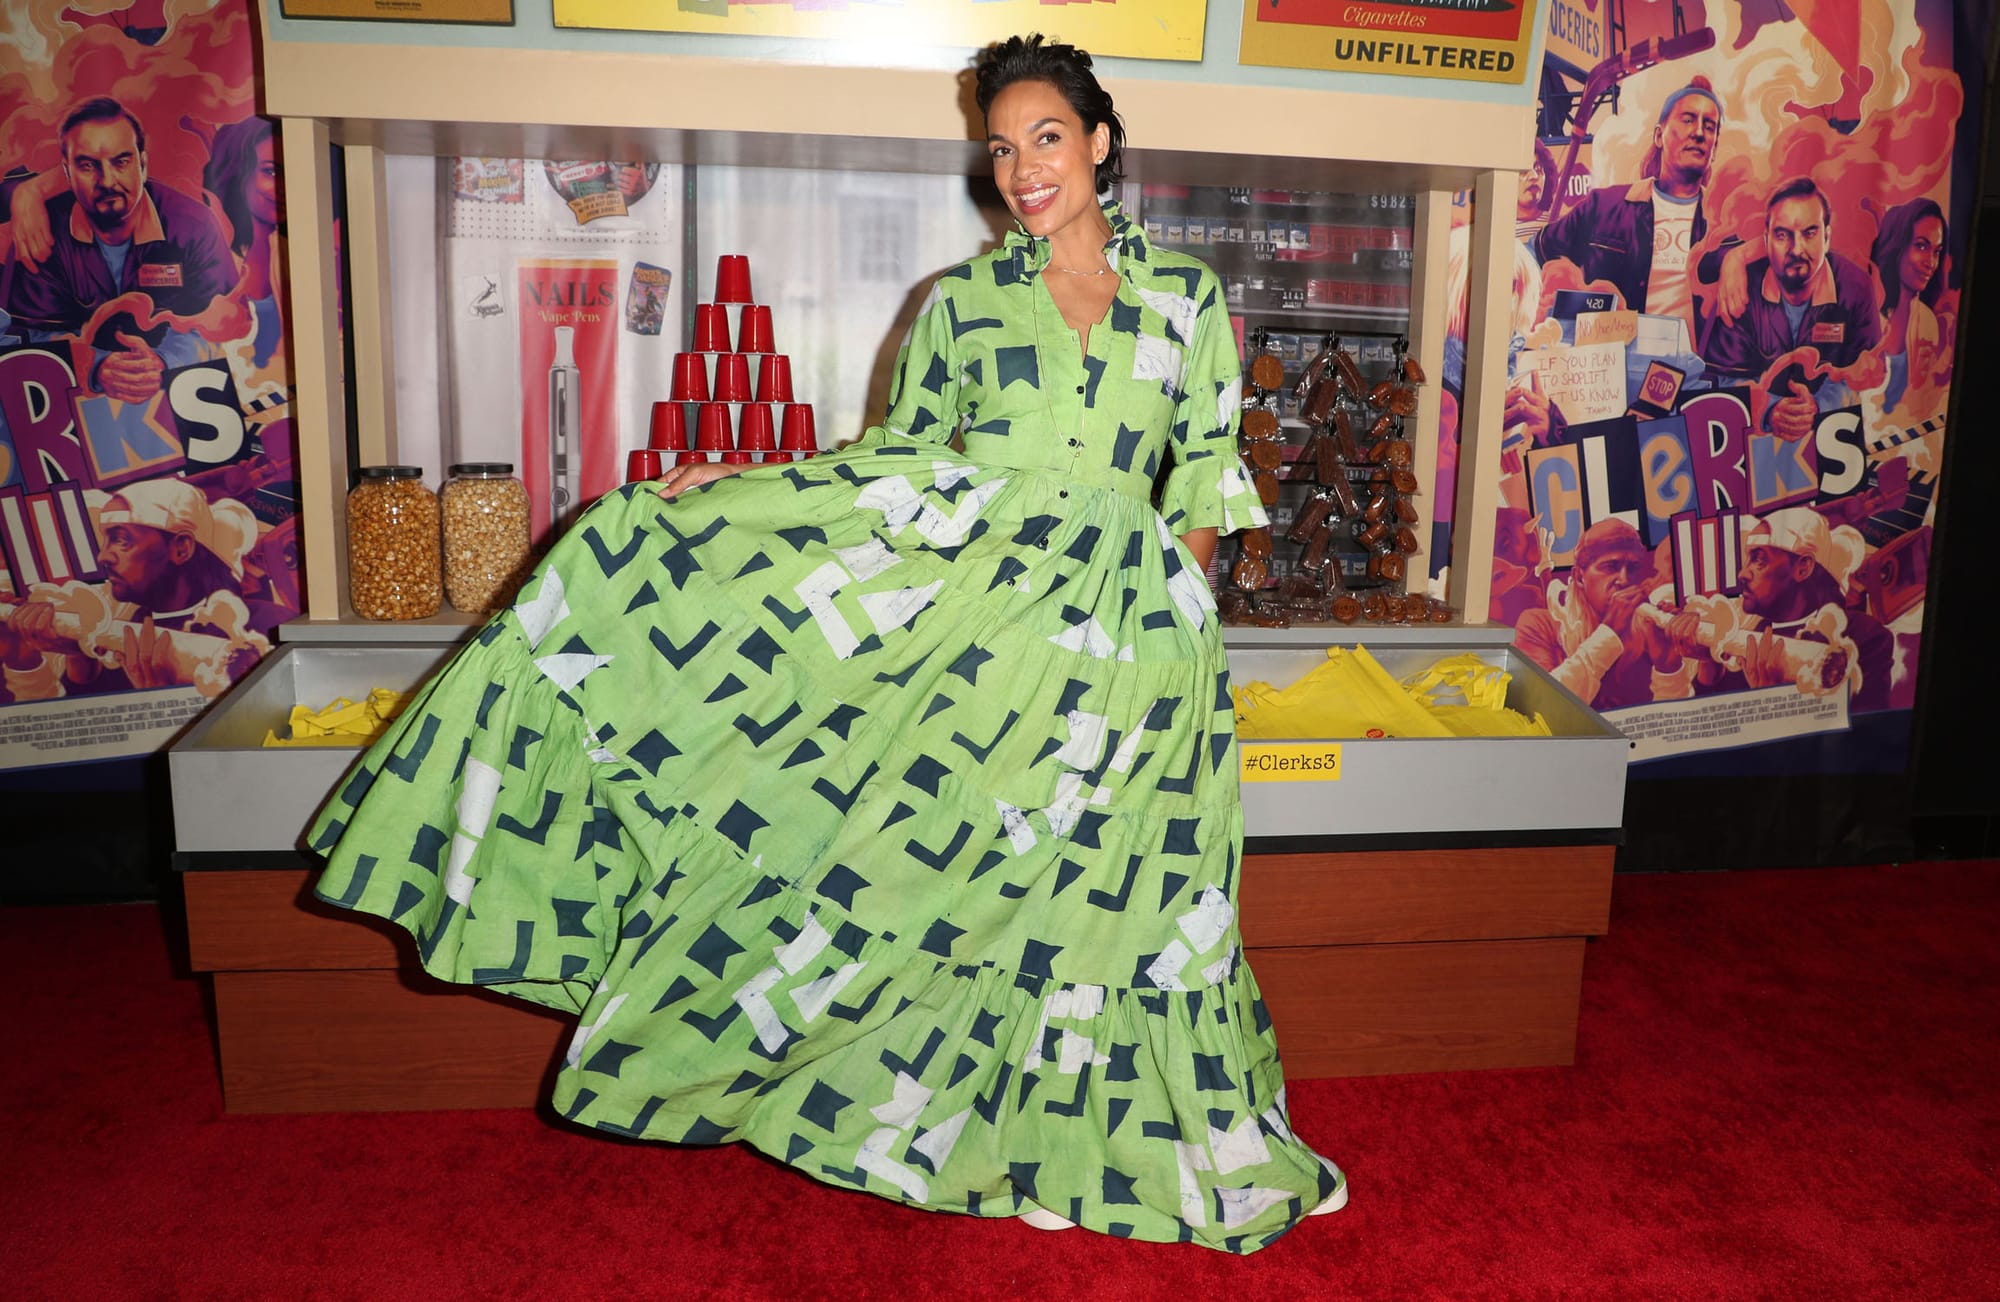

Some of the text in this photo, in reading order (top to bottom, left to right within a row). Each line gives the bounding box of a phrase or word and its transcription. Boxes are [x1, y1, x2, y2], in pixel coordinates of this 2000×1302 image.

[1343, 6, 1427, 28] Cigarettes
[1334, 38, 1515, 72] UNFILTERED
[525, 281, 615, 307] NAILS
[537, 310, 601, 325] Vape Pens
[1537, 352, 1616, 371] IF YOU PLAN
[1539, 374, 1558, 390] TO
[1650, 376, 1673, 395] STOP
[1571, 388, 1586, 402] US
[1588, 387, 1620, 402] KNOW
[1245, 753, 1336, 771] #Clerks3
